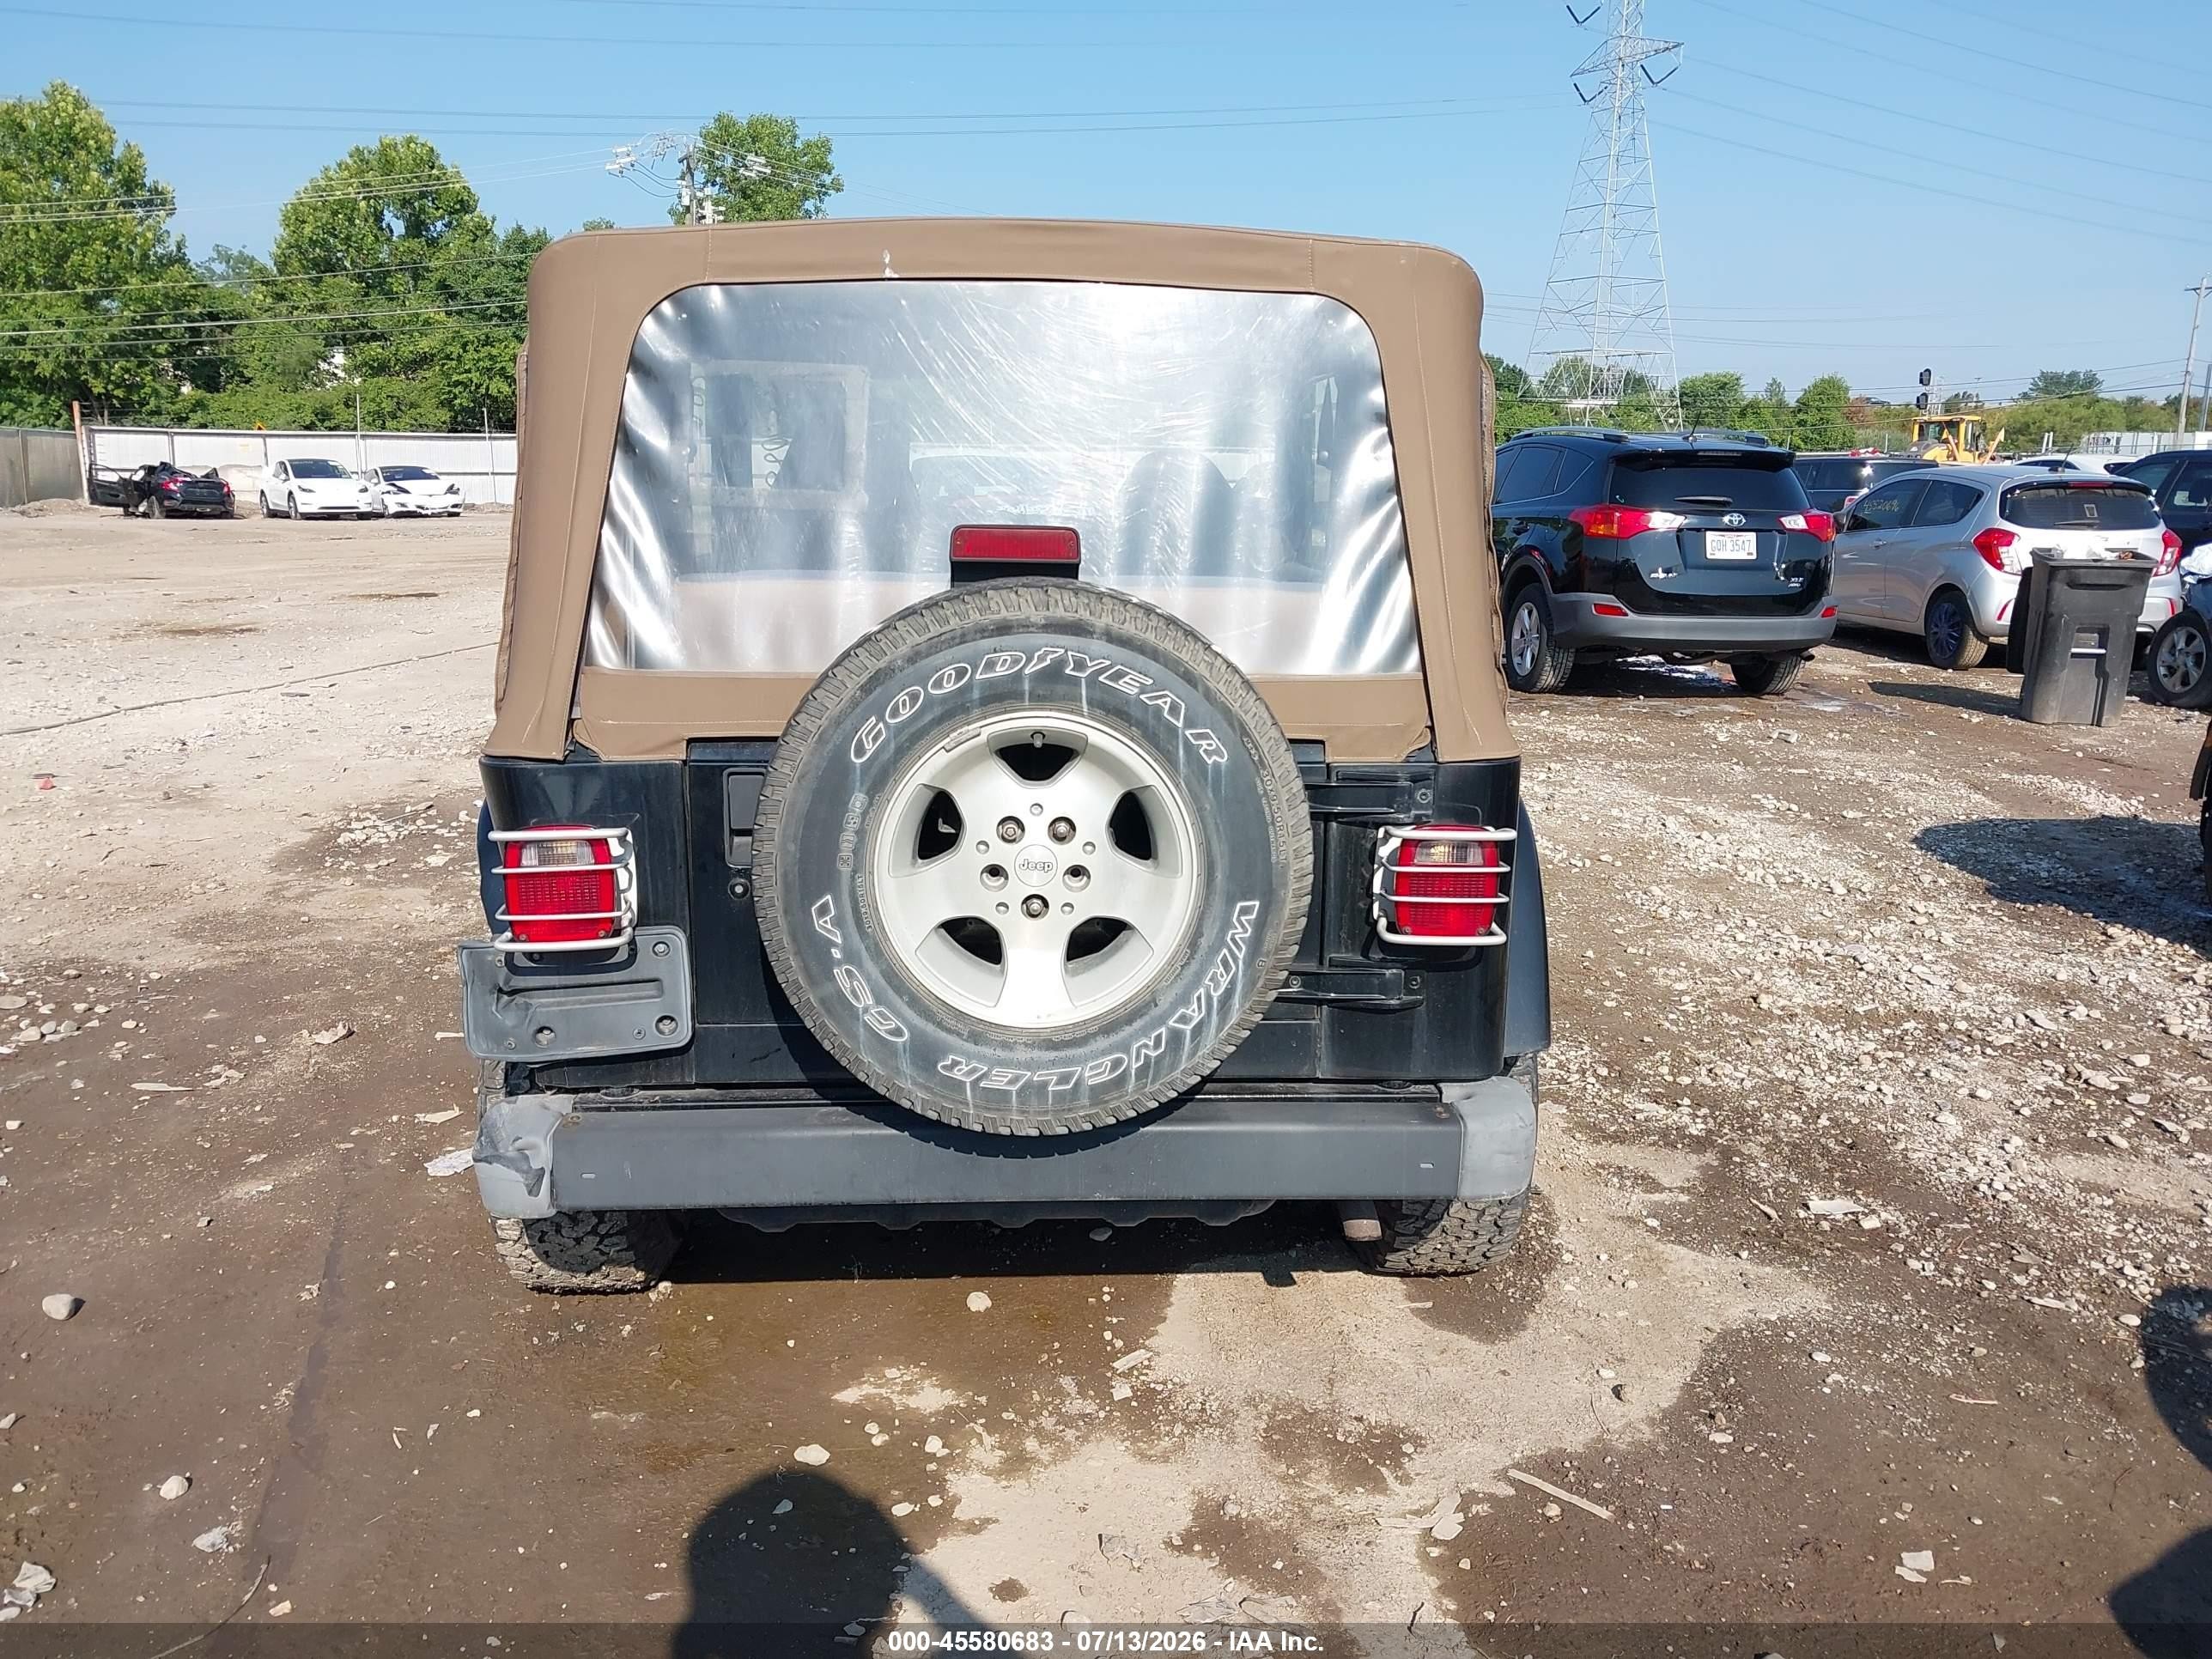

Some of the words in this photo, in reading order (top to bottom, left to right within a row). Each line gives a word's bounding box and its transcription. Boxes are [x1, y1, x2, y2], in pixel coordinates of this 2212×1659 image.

[1729, 539, 1752, 552] 3547
[851, 647, 1228, 764] GOODYEAR
[1019, 859, 1054, 873] Jeep
[938, 900, 1260, 1090] WRANGLER
